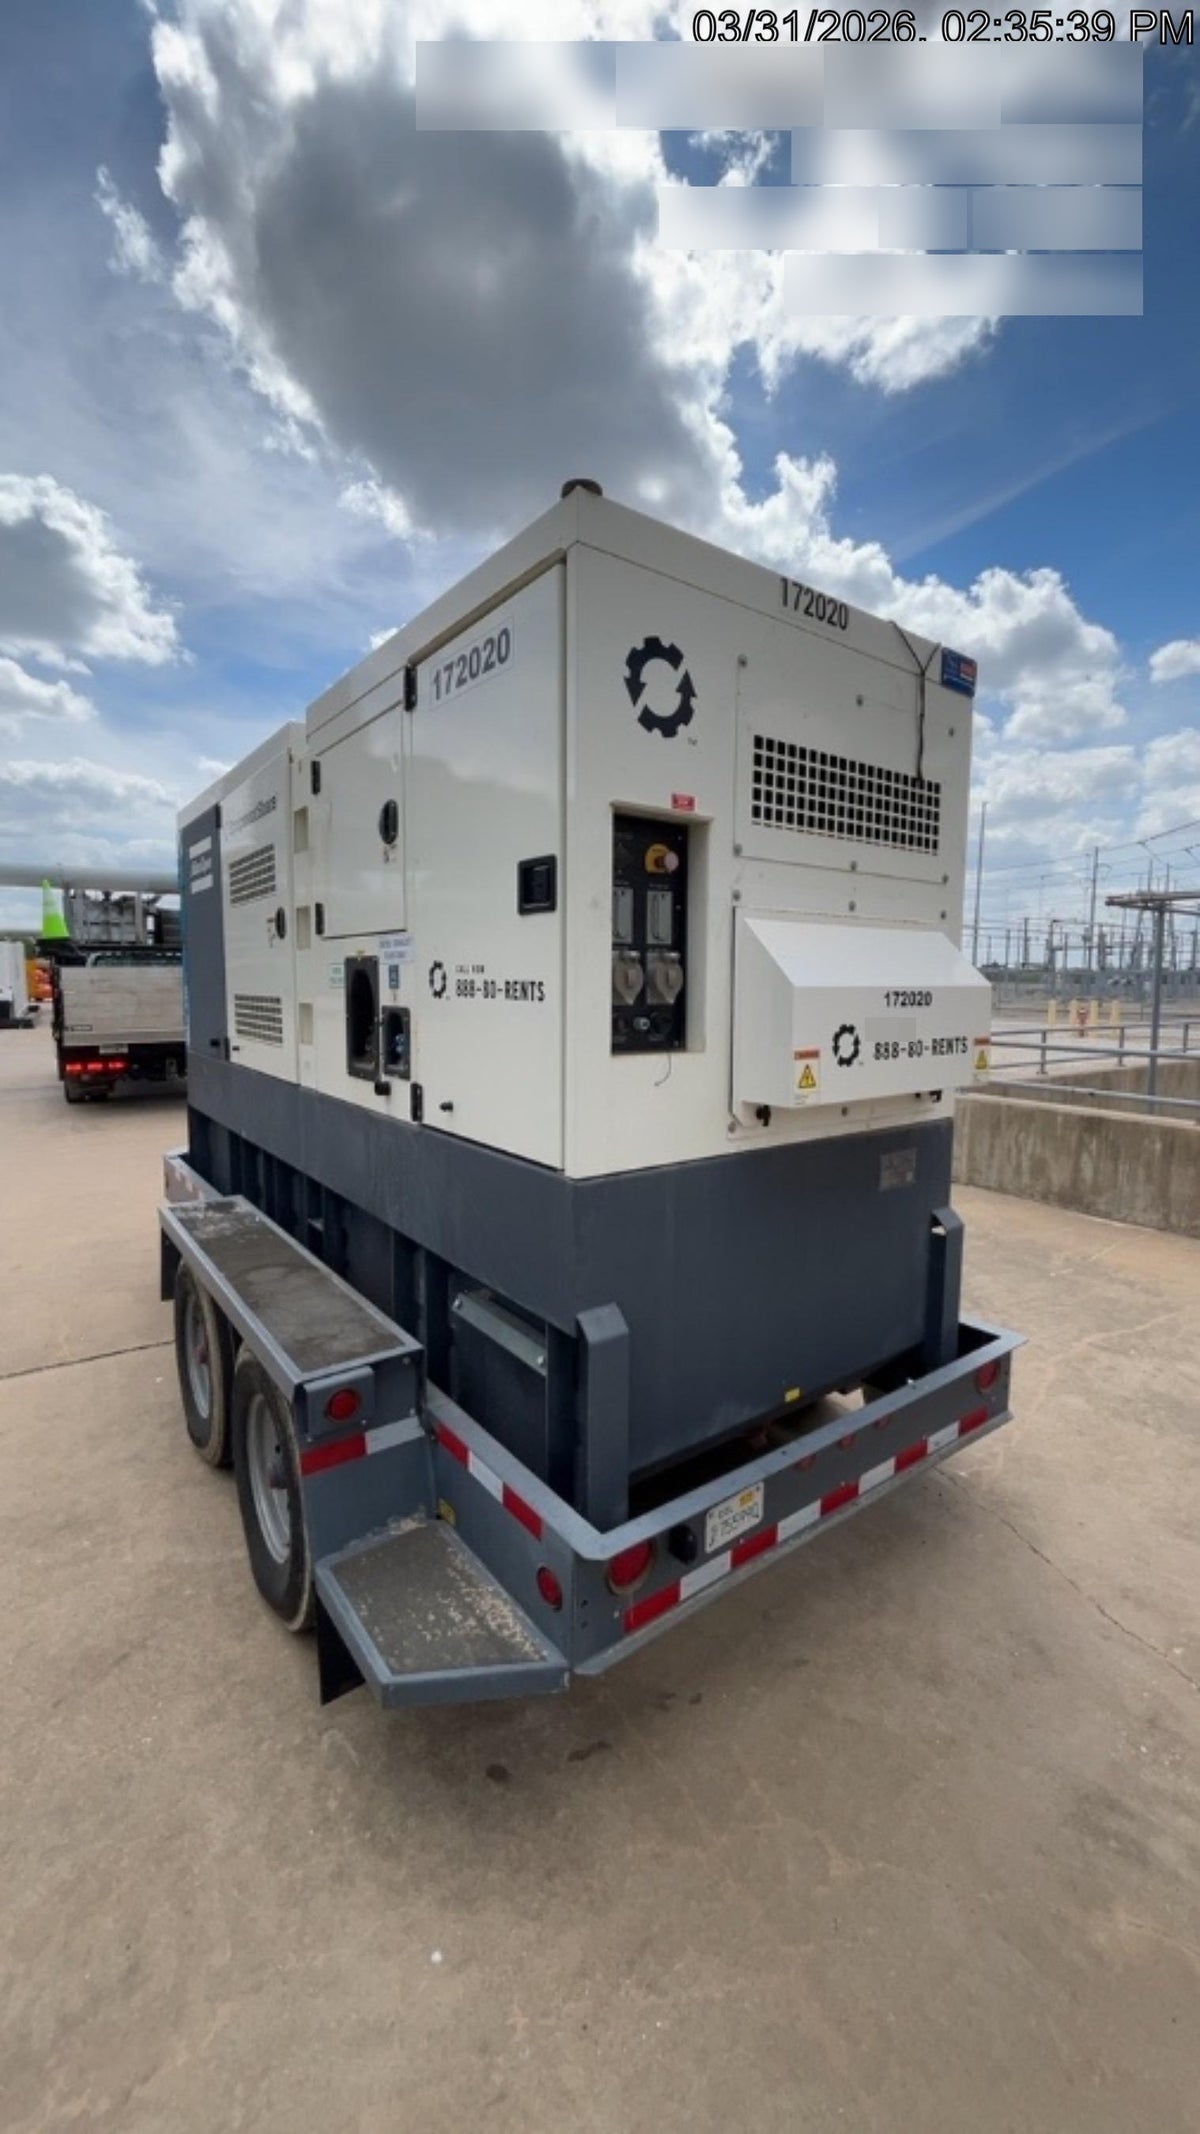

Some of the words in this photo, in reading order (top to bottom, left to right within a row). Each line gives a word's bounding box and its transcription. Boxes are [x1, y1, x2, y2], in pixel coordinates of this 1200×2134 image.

[780, 577, 848, 631] 172020
[433, 627, 511, 700] 172020
[456, 979, 546, 1002] 888-80-RENTS
[884, 990, 933, 1007] 172020
[874, 1036, 968, 1061] 888-80-RENTS
